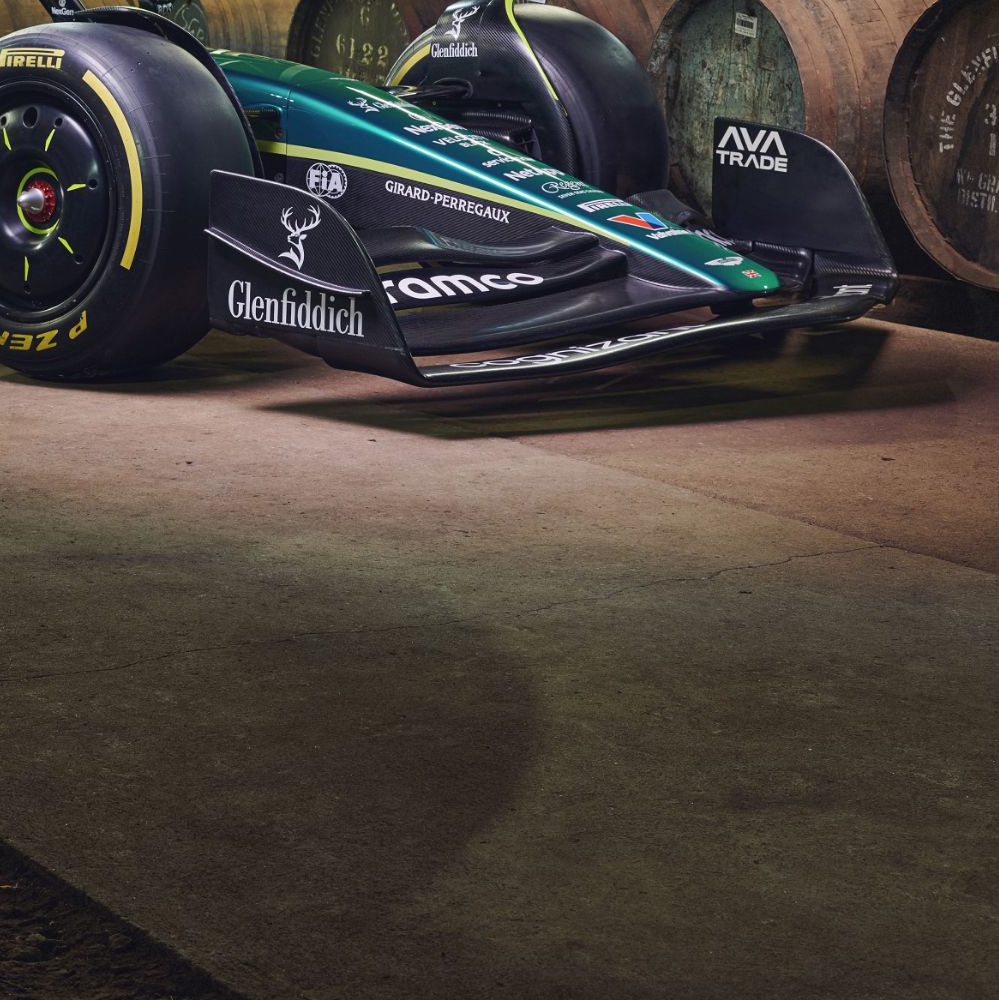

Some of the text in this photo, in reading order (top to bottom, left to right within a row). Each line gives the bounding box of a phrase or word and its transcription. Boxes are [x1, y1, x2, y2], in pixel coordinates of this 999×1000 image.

[430, 42, 478, 58] Glenfiddich
[717, 125, 787, 156] AVA
[715, 149, 789, 173] TRADE
[384, 179, 512, 223] GIRARD-PERREGAUX
[577, 198, 633, 213] PIRELLI
[382, 272, 544, 305] ramco
[228, 279, 365, 338] Glenfiddich
[68, 310, 88, 340] P
